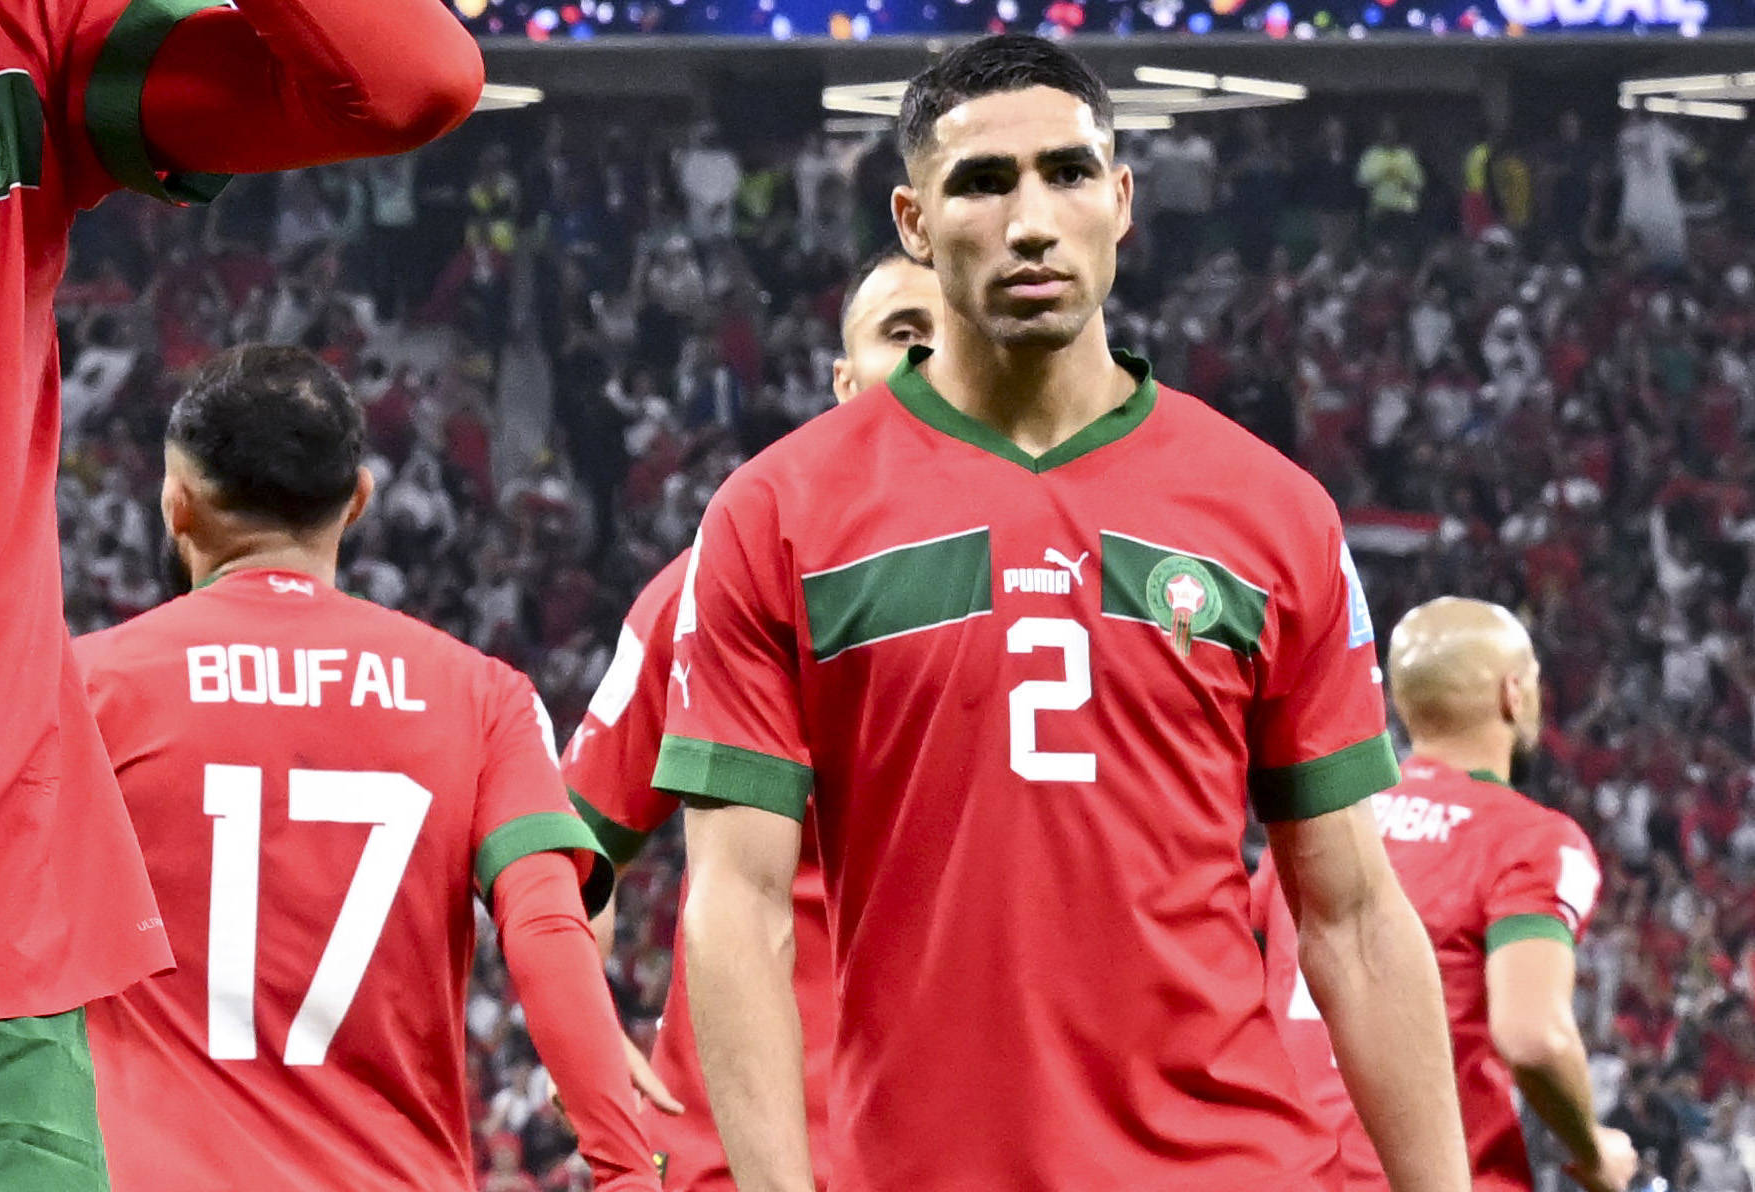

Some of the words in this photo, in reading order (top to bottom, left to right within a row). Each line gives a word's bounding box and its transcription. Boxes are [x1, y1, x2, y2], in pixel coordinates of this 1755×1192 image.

[1003, 568, 1071, 594] PUMA
[186, 643, 427, 712] BOUFAL
[1007, 617, 1096, 782] 2
[203, 763, 434, 1066] 17
